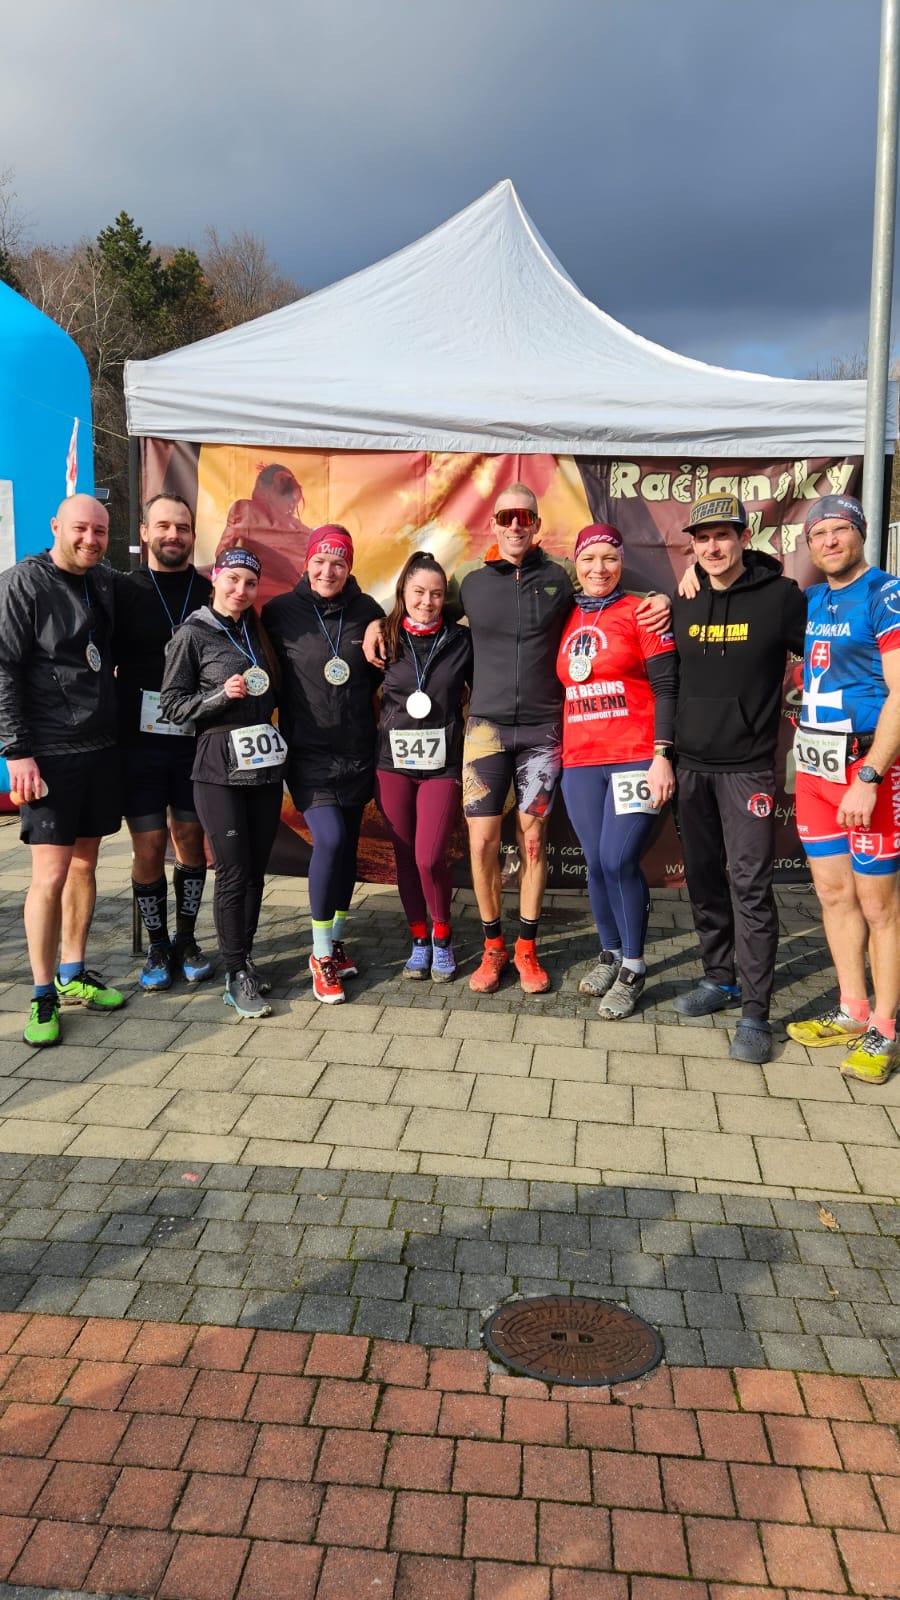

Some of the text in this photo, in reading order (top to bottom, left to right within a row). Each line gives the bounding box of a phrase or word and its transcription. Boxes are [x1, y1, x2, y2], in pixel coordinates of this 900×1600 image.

[609, 459, 855, 503] Račiansky
[745, 511, 804, 554] kr
[805, 621, 851, 637] SLOVAKIA
[579, 680, 625, 698] BEGINS
[576, 697, 598, 714] THE
[600, 695, 627, 710] END
[238, 733, 285, 758] 301
[395, 737, 441, 759] 347
[796, 743, 839, 773] 196
[618, 780, 651, 802] 36
